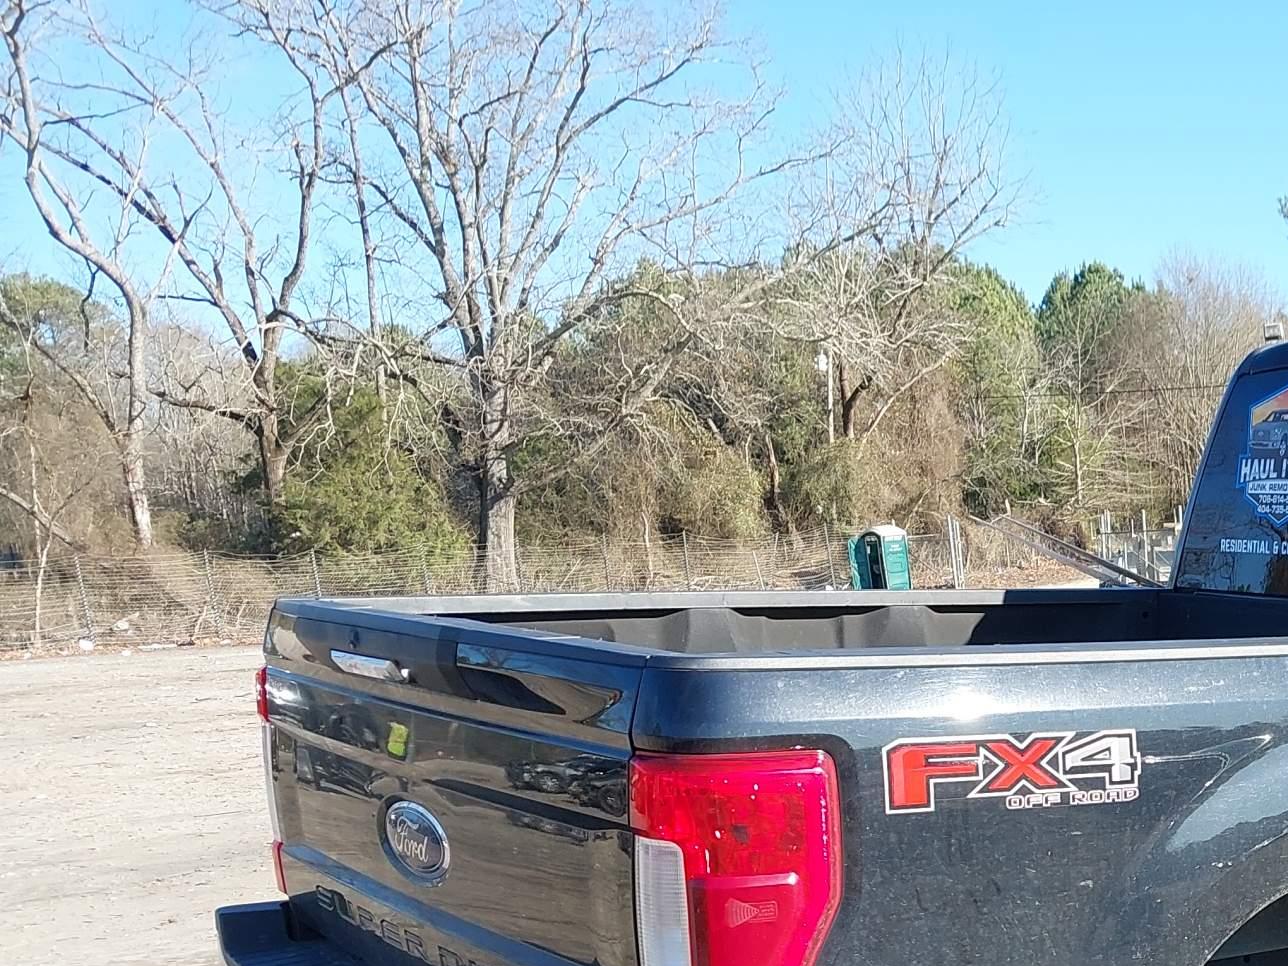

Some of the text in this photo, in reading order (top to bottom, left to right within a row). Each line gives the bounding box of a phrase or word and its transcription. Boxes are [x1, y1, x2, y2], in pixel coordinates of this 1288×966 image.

[1240, 458, 1278, 483] HAUL
[1250, 482, 1267, 492] JUNK
[1220, 539, 1270, 554] RESIDENTIAL
[1273, 541, 1279, 555] &
[882, 729, 1141, 815] FX4
[1005, 786, 1140, 809] OFF ROAD
[395, 816, 429, 863] Ford
[315, 884, 430, 963] SUPER
